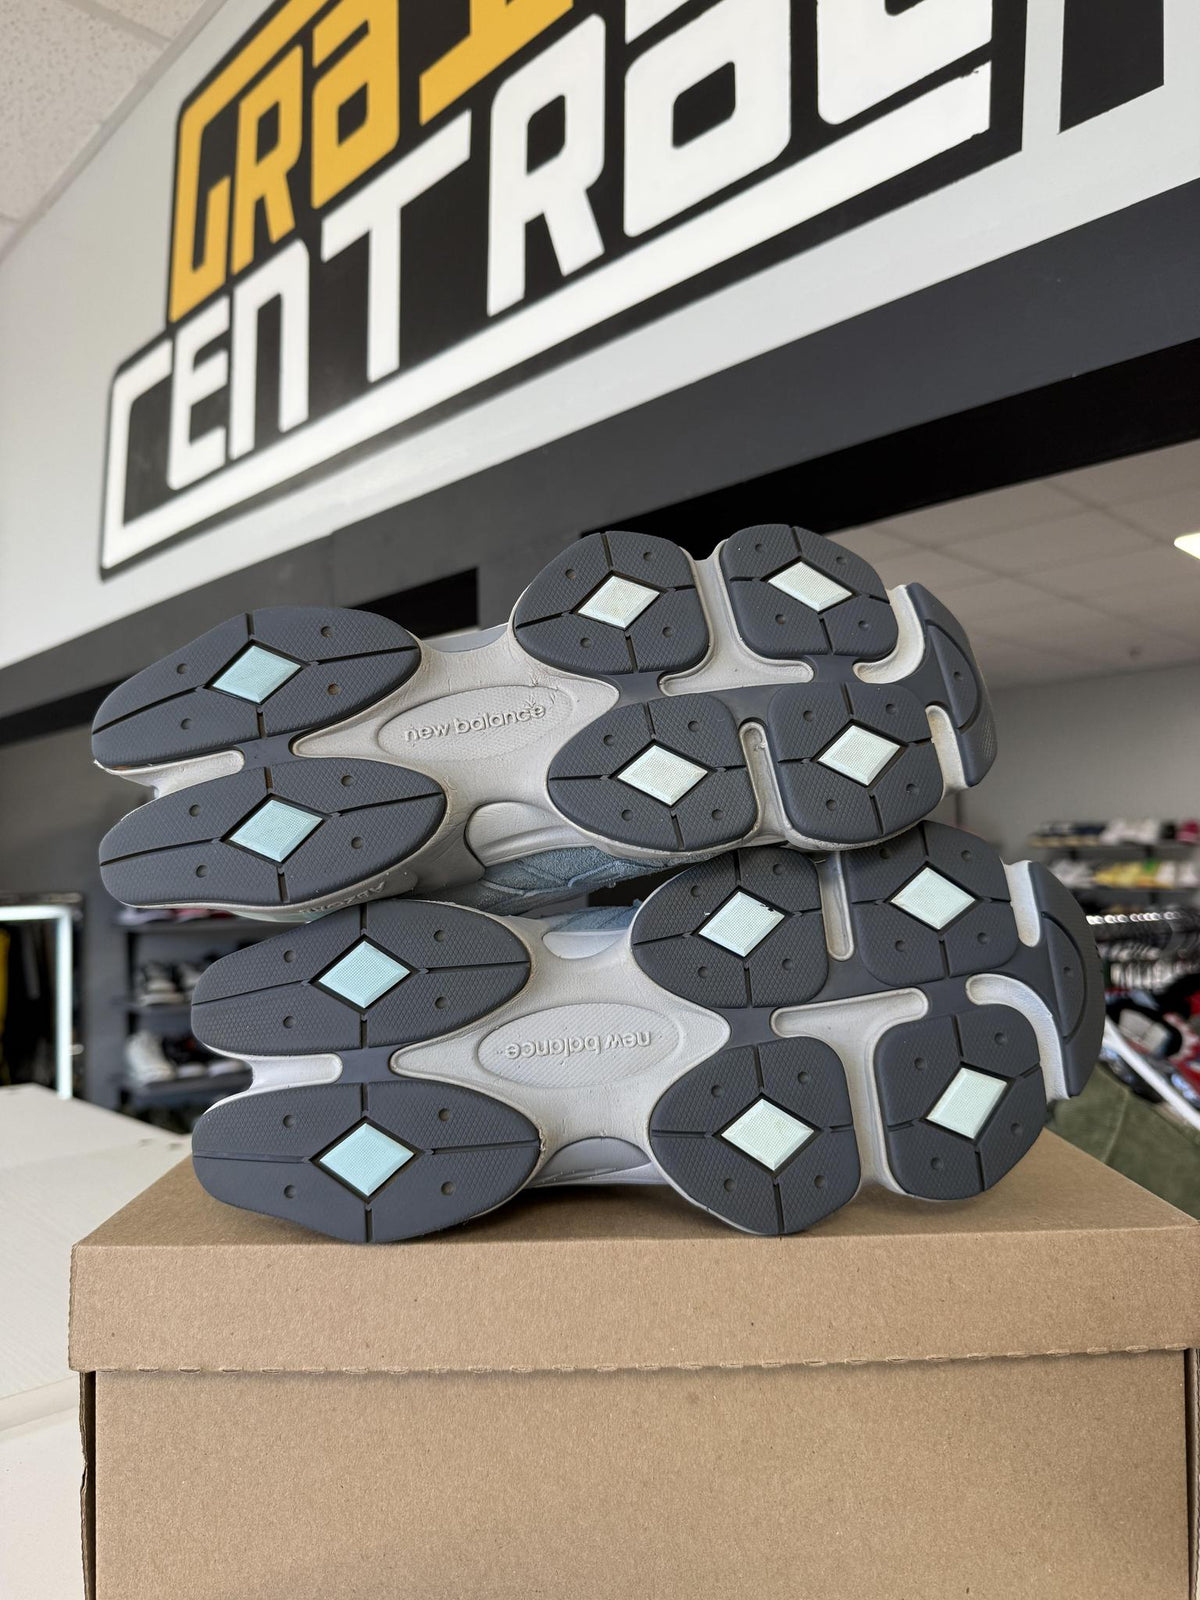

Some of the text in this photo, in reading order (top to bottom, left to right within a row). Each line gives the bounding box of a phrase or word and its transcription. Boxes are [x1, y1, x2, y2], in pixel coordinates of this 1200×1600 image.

[404, 703, 546, 742] new balance
[504, 1030, 652, 1060] new balance
